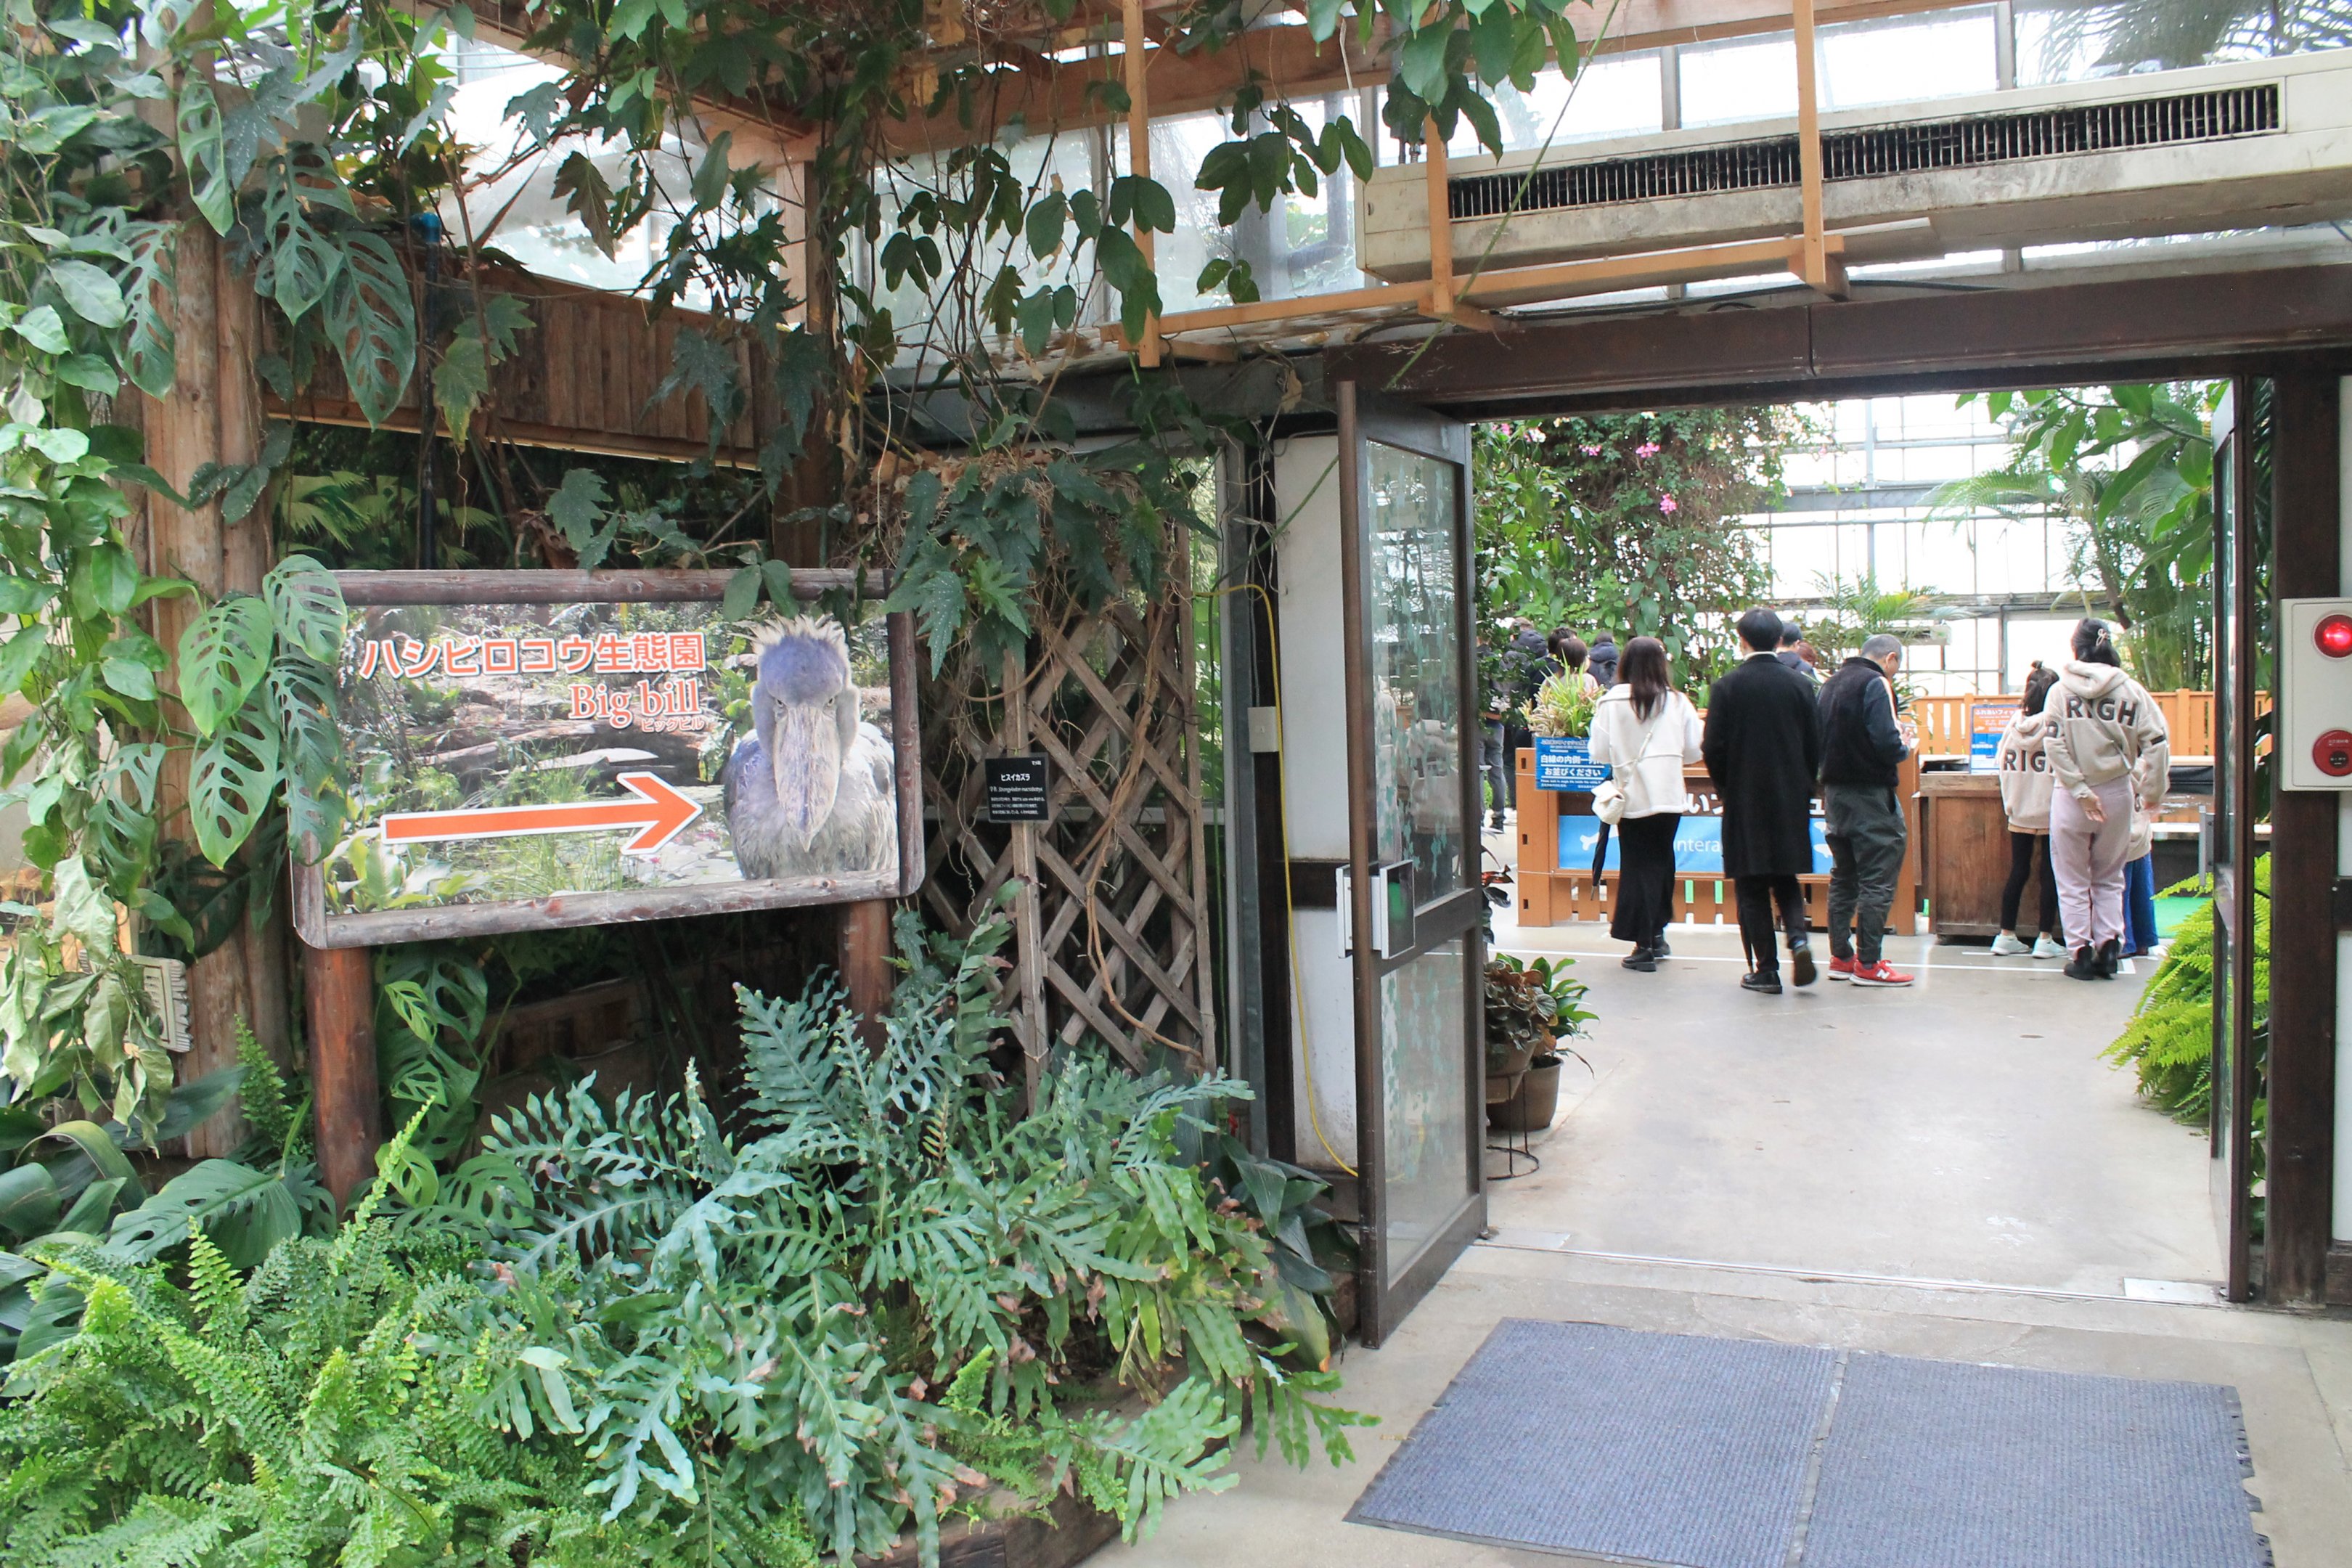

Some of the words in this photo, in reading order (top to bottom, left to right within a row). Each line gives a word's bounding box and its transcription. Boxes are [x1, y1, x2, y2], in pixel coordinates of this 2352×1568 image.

[360, 632, 707, 679] ハシビロコウ生態園
[568, 683, 633, 728] Big
[638, 678, 702, 717] bill
[642, 715, 706, 732] ビッグビル
[2004, 748, 2054, 773] RIG
